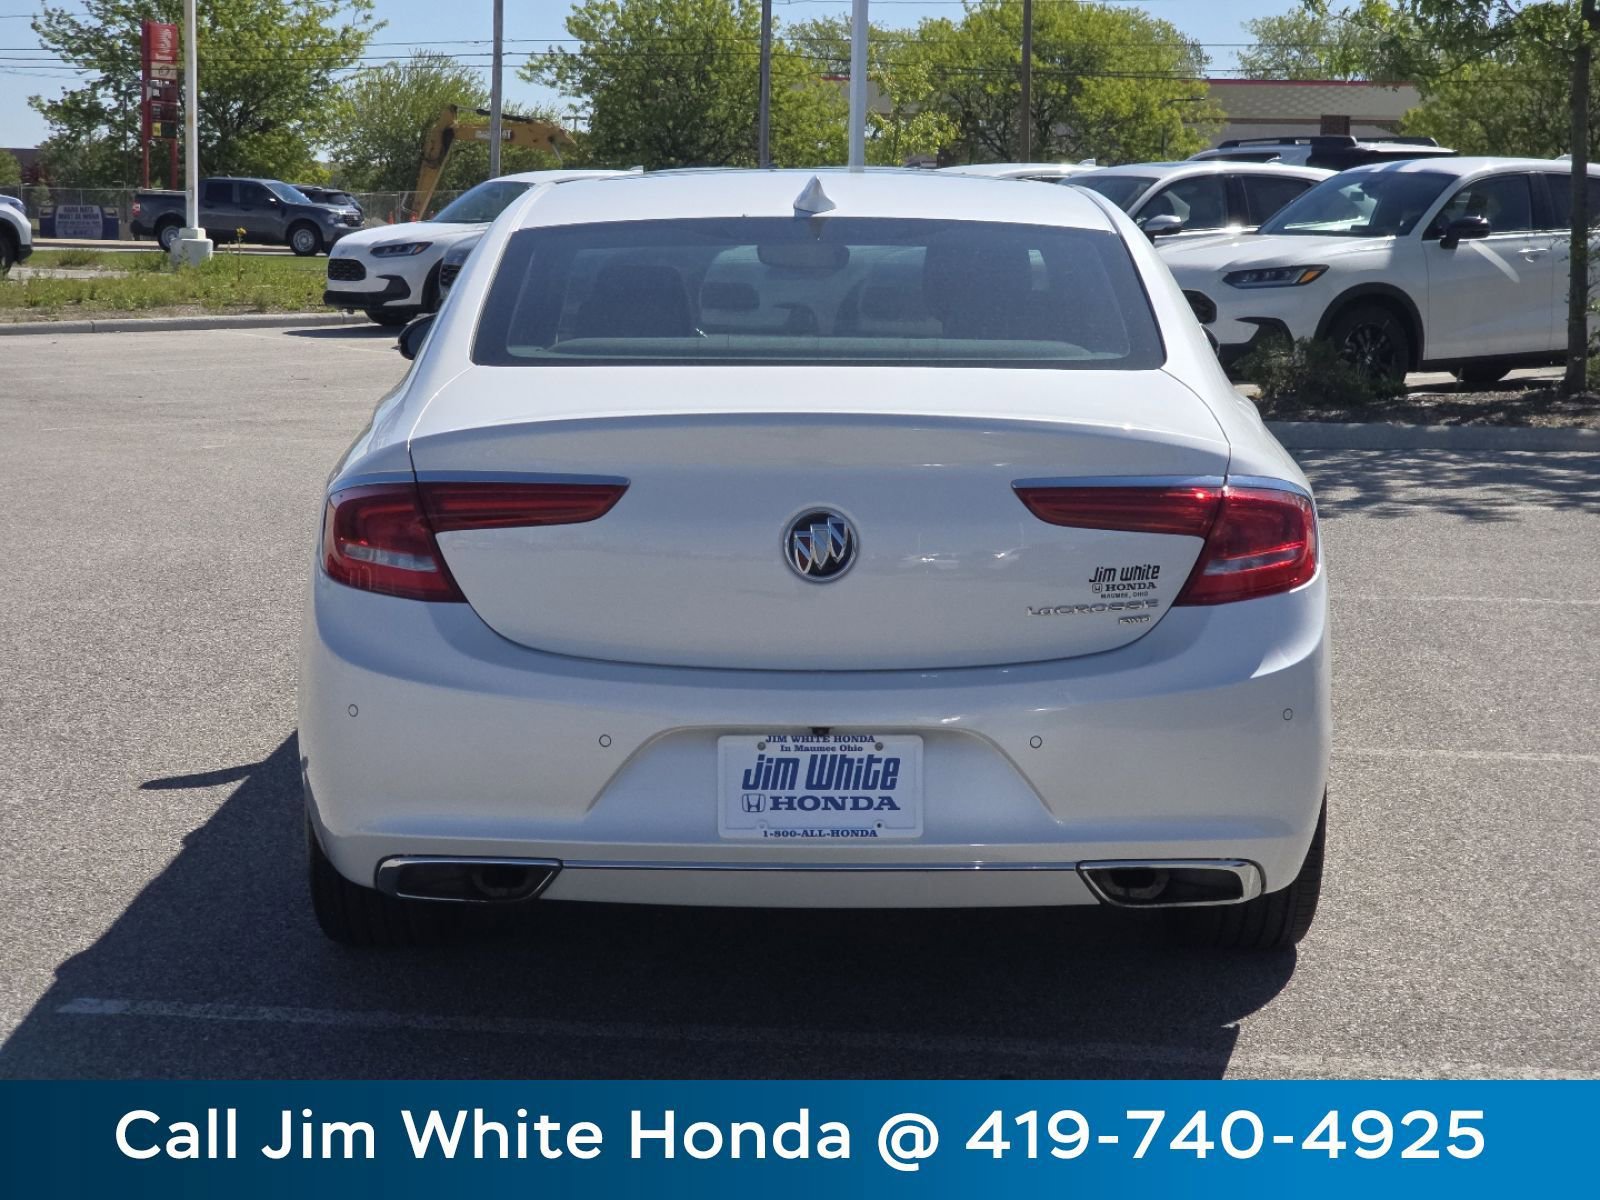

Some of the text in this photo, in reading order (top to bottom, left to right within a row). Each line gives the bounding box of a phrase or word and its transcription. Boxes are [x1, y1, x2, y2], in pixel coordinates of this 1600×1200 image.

[1088, 566, 1117, 583] Jim
[1105, 581, 1158, 592] HONDA
[765, 735, 876, 743] JIM WHITE HONDA
[839, 744, 864, 752] Ohio
[805, 754, 901, 791] White
[769, 795, 901, 811] HONDA
[762, 829, 878, 838] 1-800-ALL-HONDA
